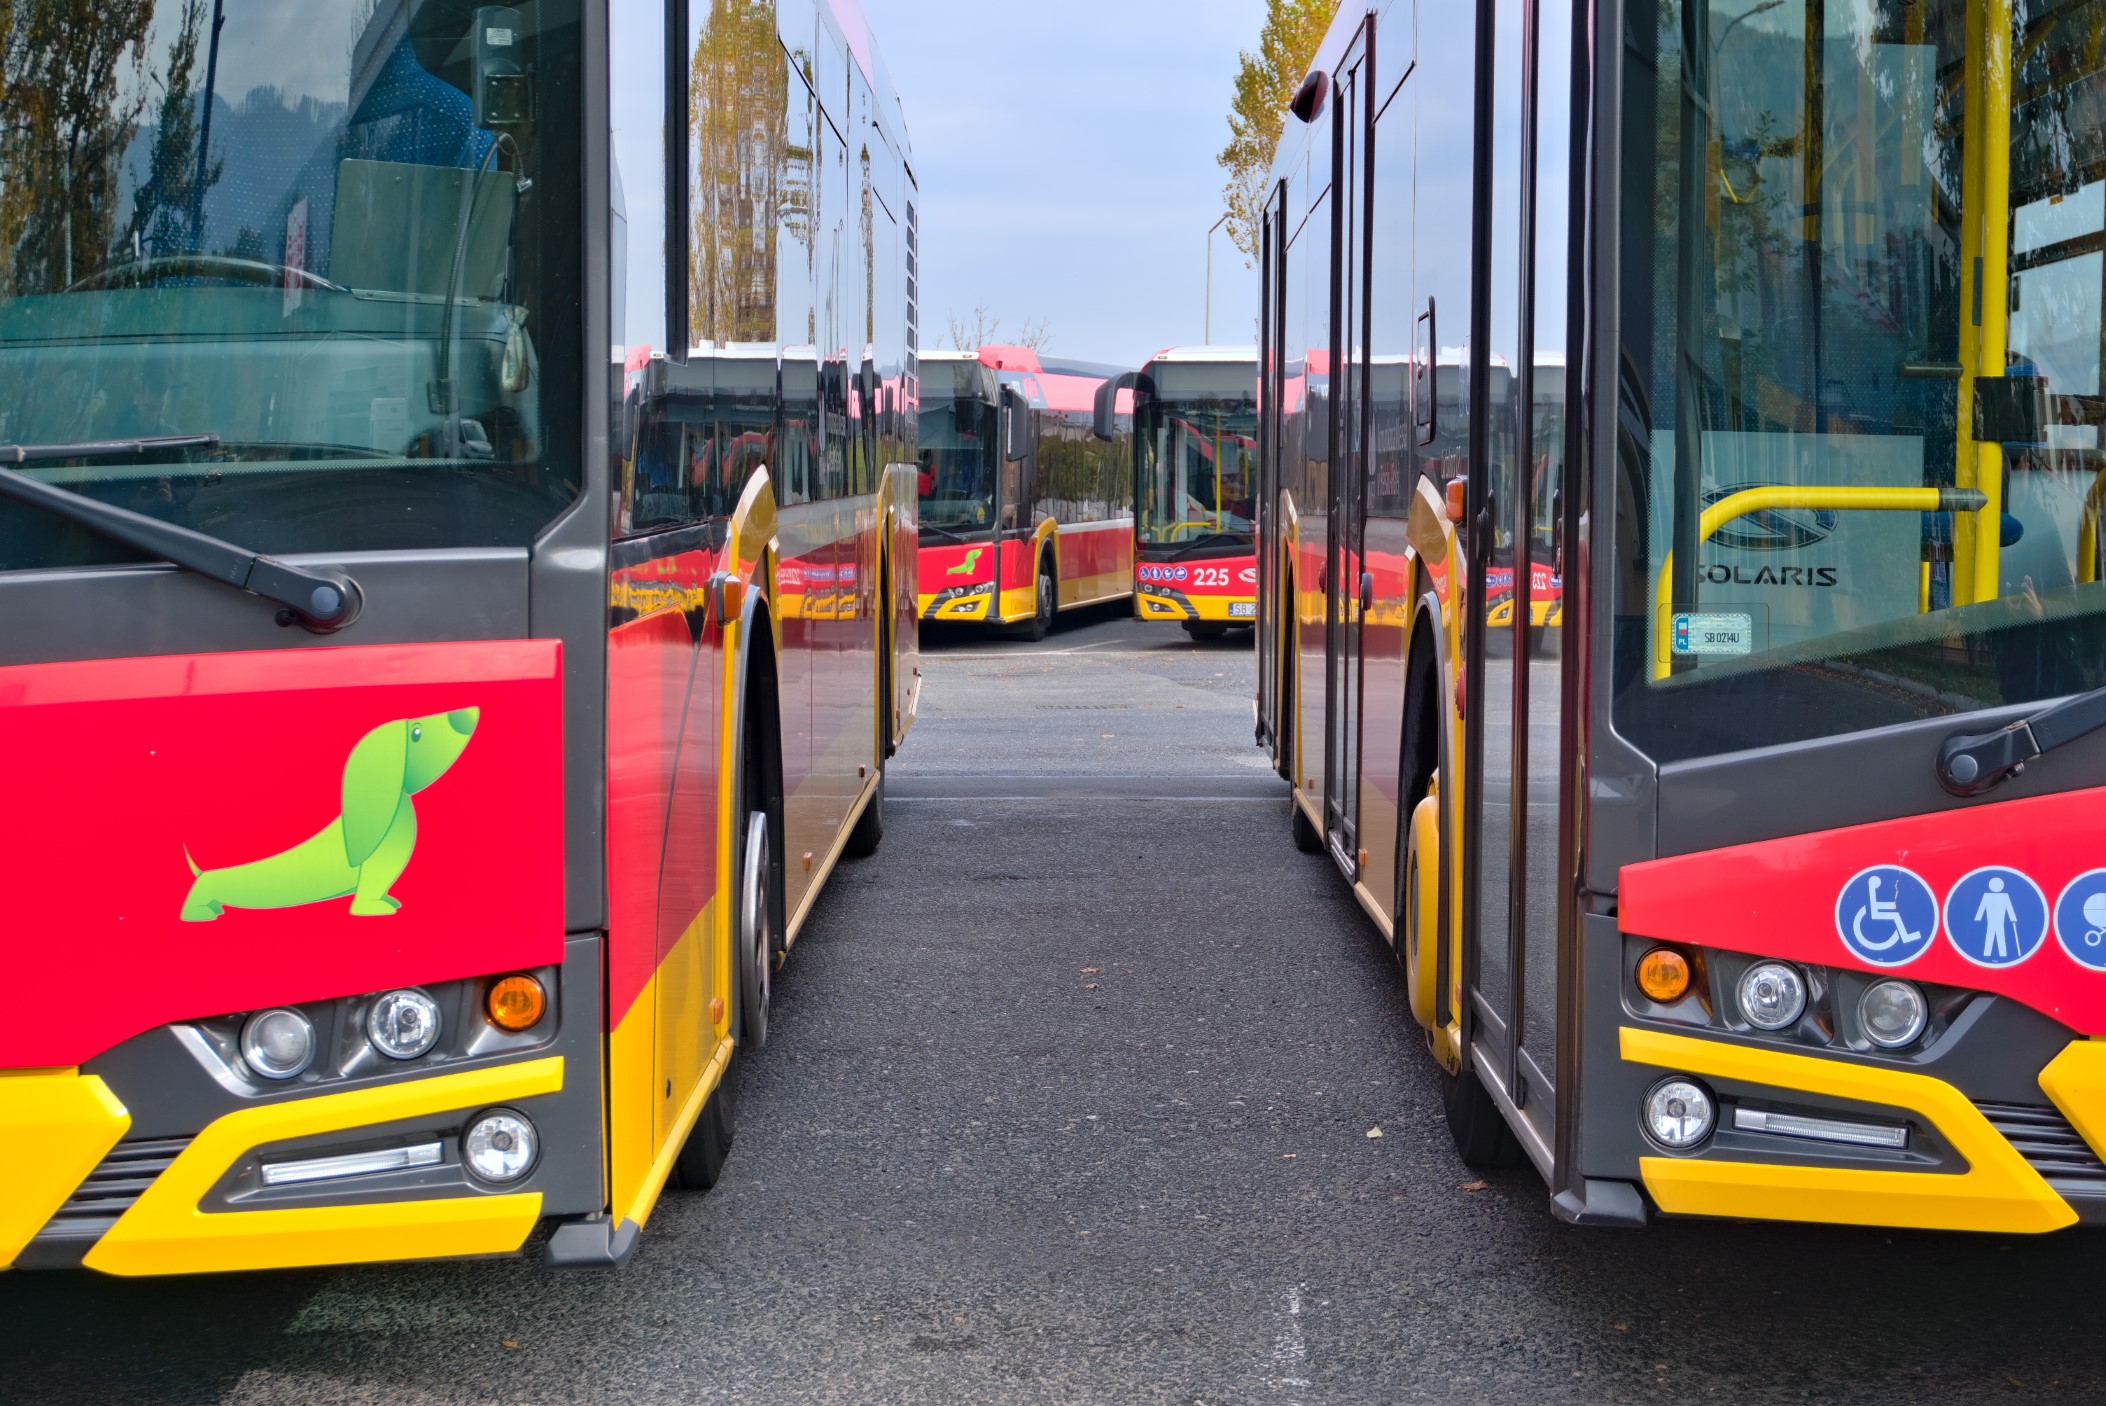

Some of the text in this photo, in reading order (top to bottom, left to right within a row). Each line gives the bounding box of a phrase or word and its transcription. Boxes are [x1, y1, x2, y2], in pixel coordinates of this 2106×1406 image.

[1193, 568, 1229, 586] 225
[1235, 604, 1247, 614] SB
[1704, 632, 1740, 644] SB 0214U
